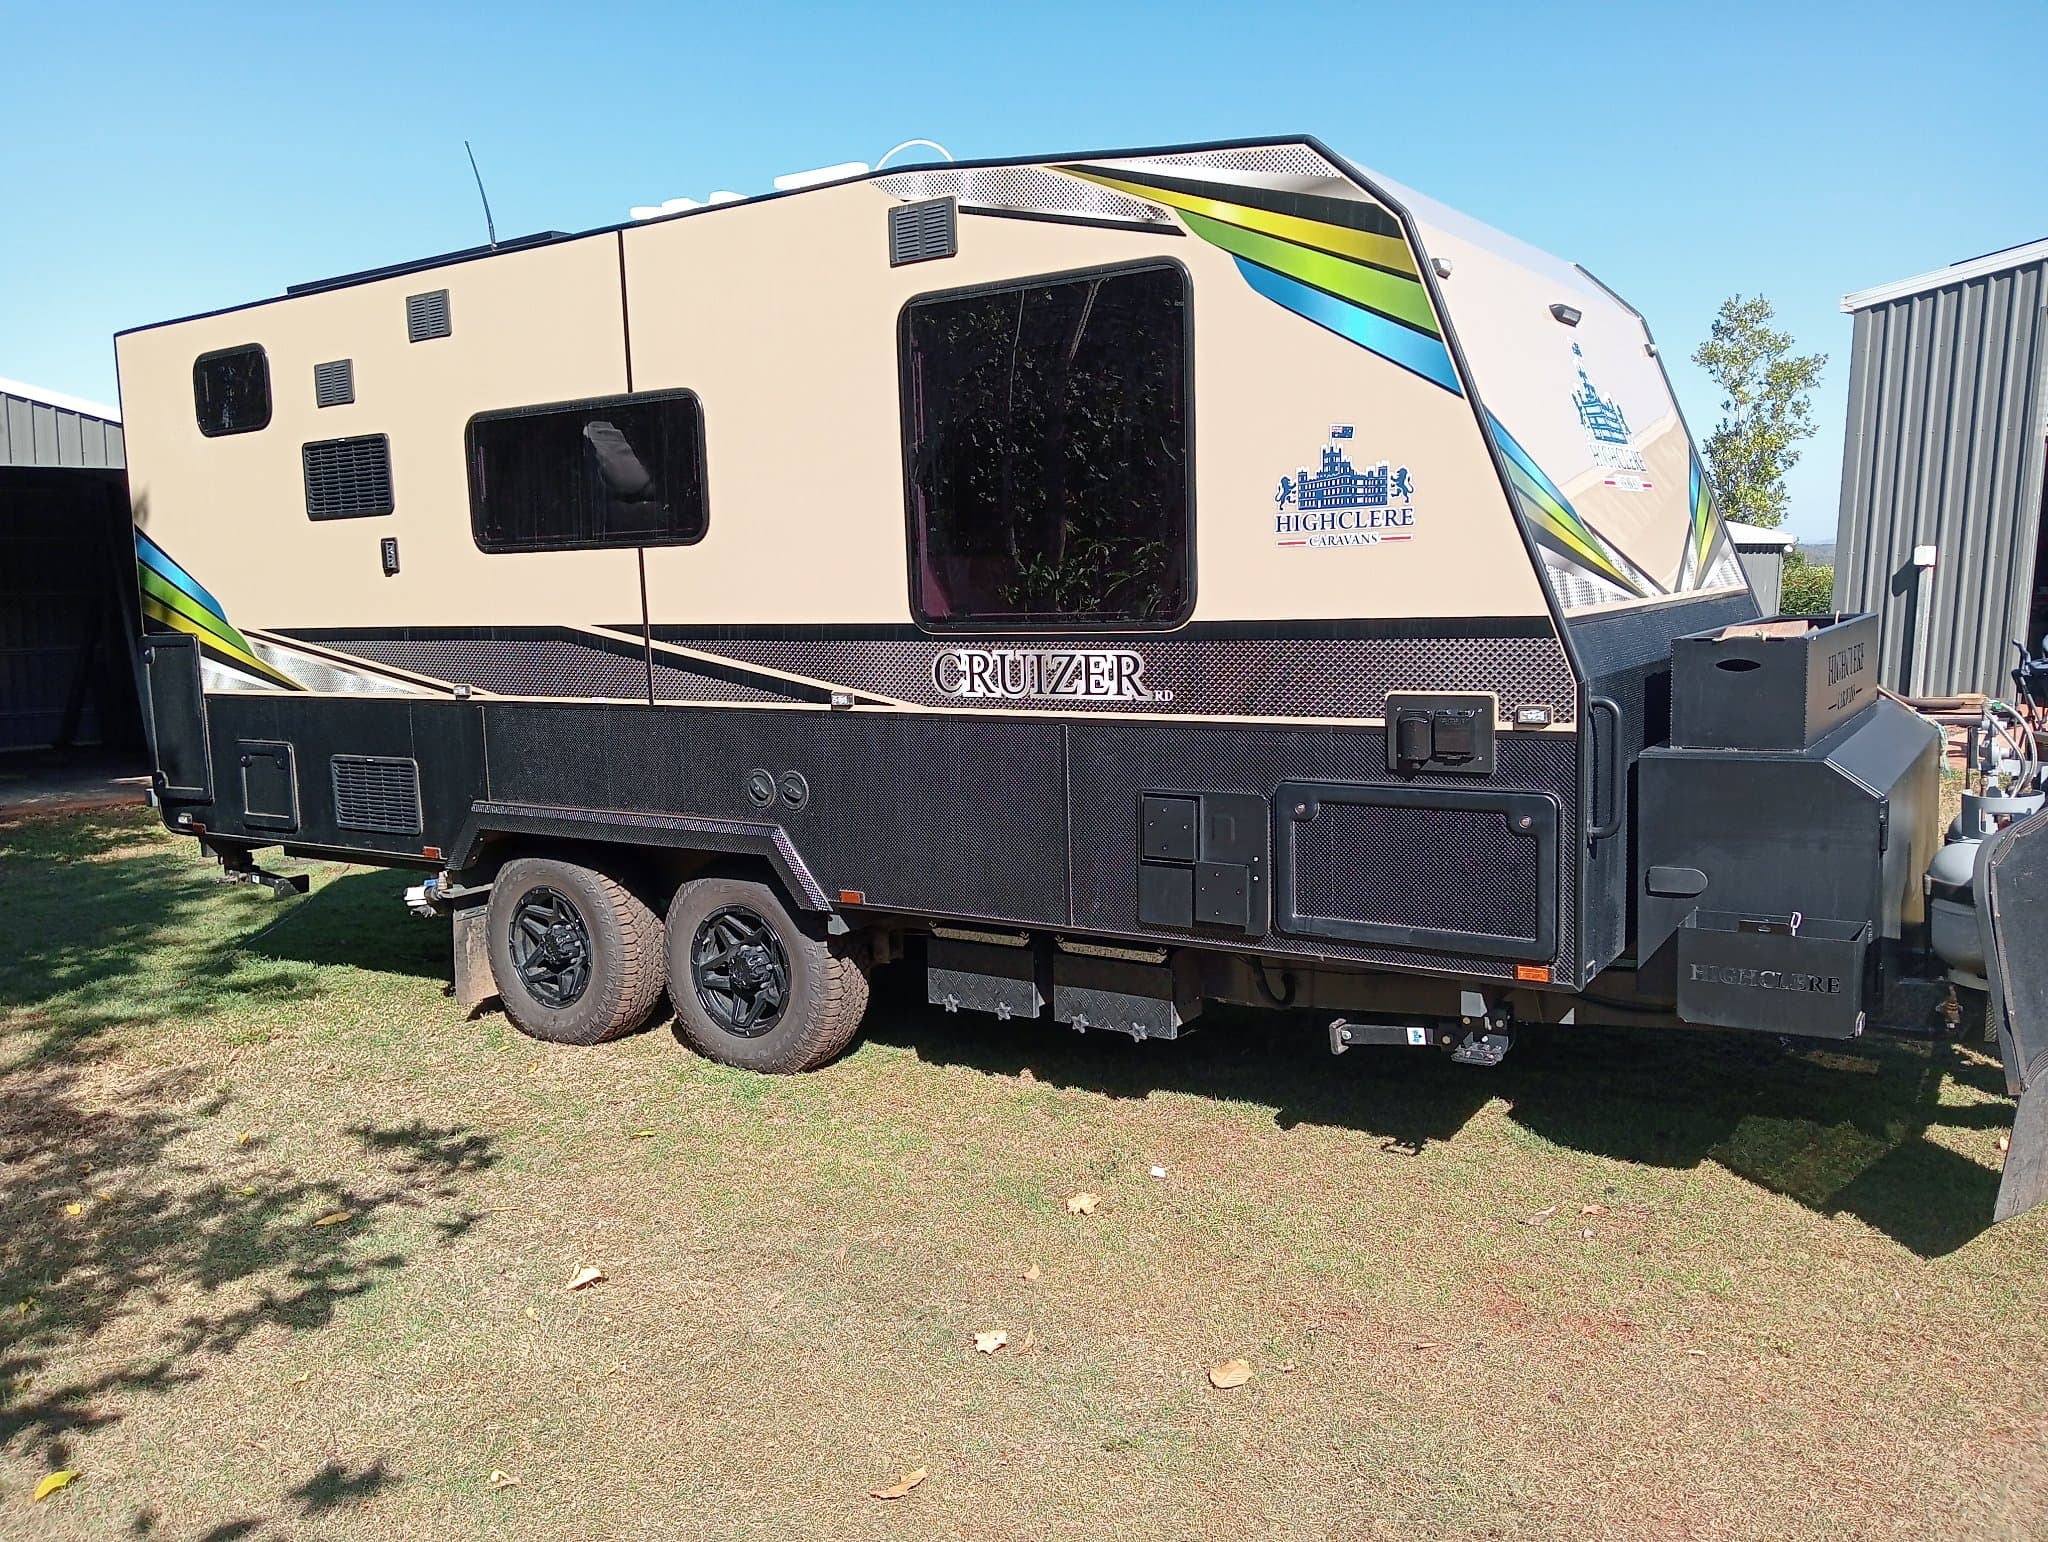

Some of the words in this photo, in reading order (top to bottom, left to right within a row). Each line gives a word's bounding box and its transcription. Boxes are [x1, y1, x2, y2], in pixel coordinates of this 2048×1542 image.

[1275, 508, 1415, 533] HIGHCLERE
[1309, 534, 1378, 547] CARAVANS
[933, 650, 1150, 700] CRUIZER
[1154, 689, 1174, 702] RD
[1689, 963, 1841, 994] HIGHCLERE
